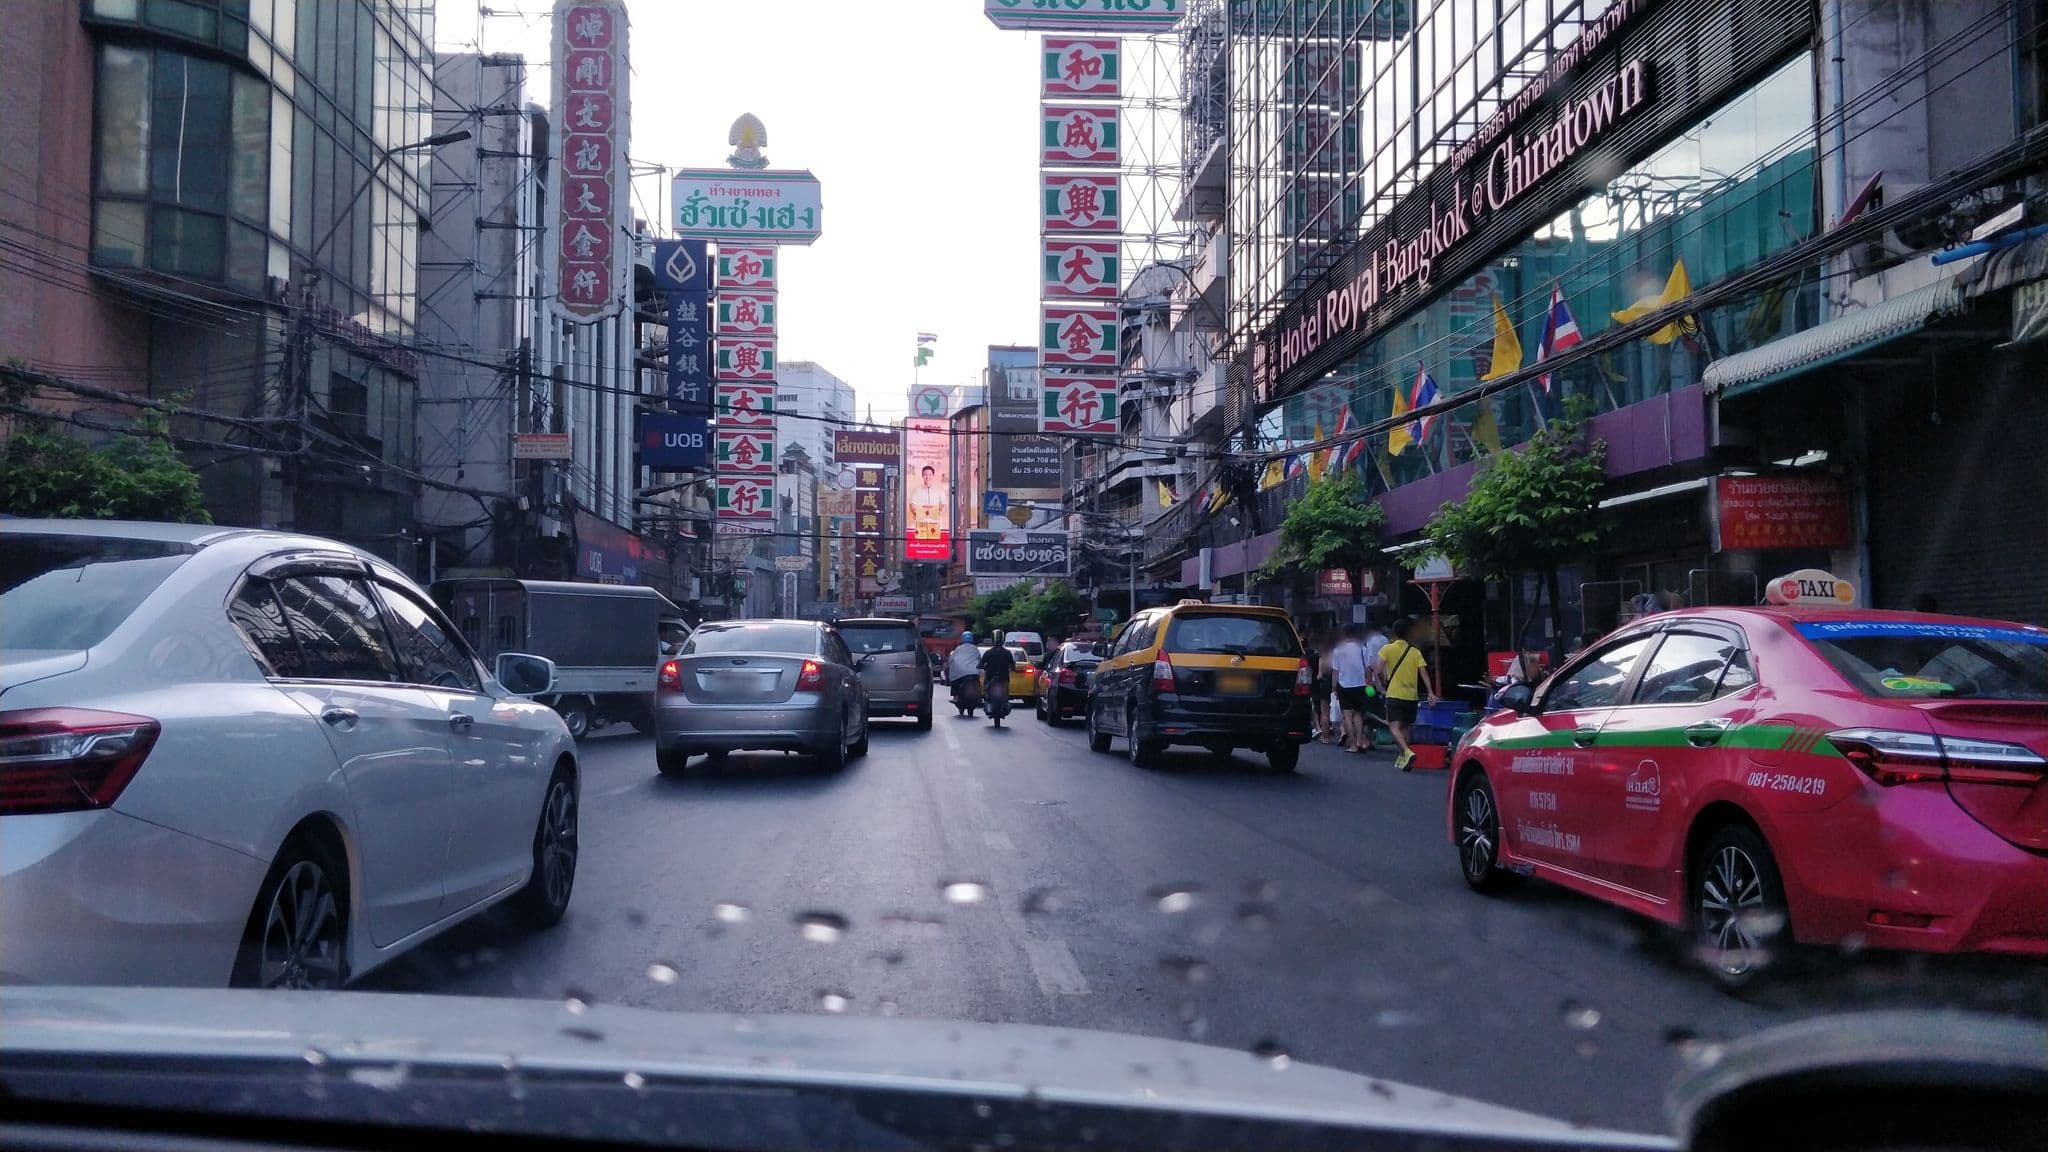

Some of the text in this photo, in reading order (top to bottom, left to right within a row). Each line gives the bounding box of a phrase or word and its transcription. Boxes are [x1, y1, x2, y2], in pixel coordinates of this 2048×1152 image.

[680, 189, 813, 230] ฮั่วเซ่งเฮง
[709, 184, 780, 197] ห้างขายทอง
[1060, 48, 1102, 425] 和成興大金行
[1280, 296, 1322, 374] Hotel
[1327, 249, 1378, 333] Royal
[1385, 184, 1470, 286] Bangkok
[1487, 58, 1642, 212] Chinatown
[676, 300, 701, 402] 盤谷銀行
[731, 254, 764, 513] 和成興大金行
[664, 432, 704, 448] UOB
[1798, 580, 1836, 597] TAXI
[1747, 772, 1826, 795] 081-2584219
